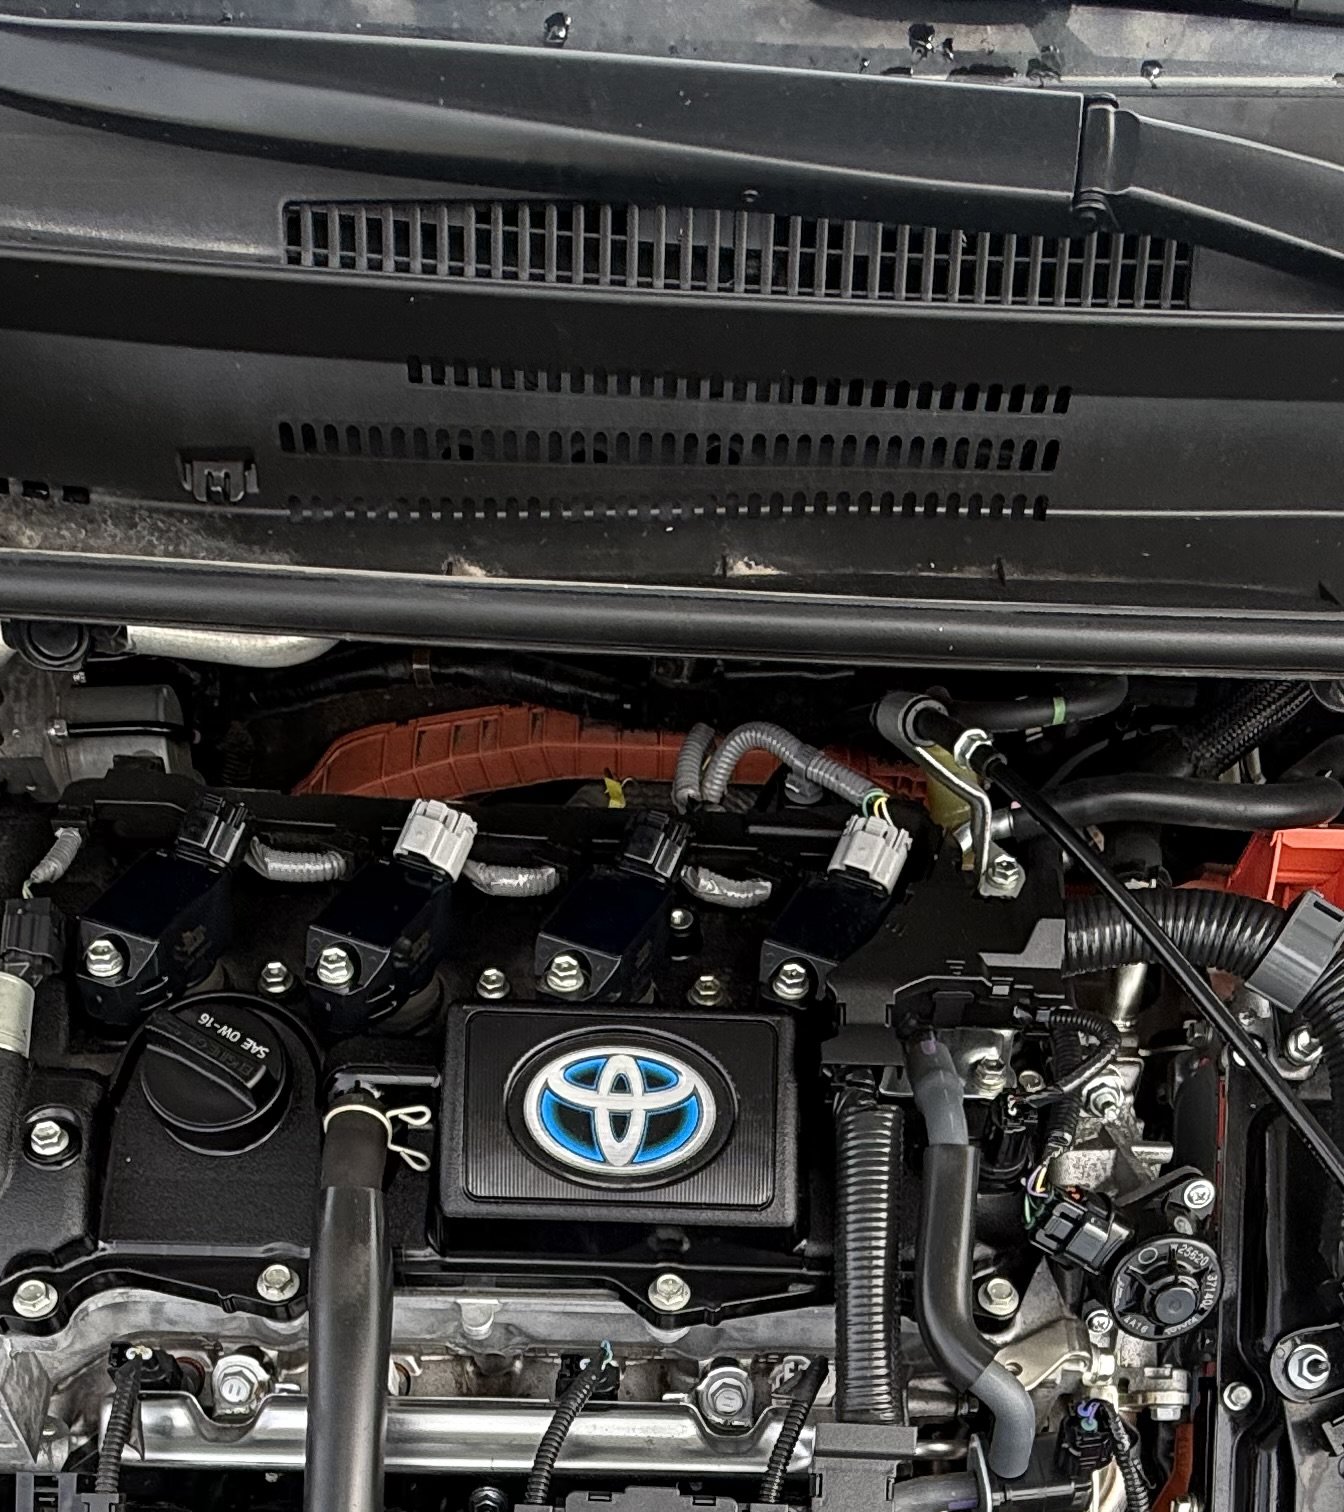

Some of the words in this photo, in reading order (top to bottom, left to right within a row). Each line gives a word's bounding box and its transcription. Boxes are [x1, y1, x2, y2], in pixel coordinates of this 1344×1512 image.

[197, 1012, 242, 1043] 0W-16
[240, 1037, 270, 1060] SAE
[1177, 1243, 1210, 1267] 25620
